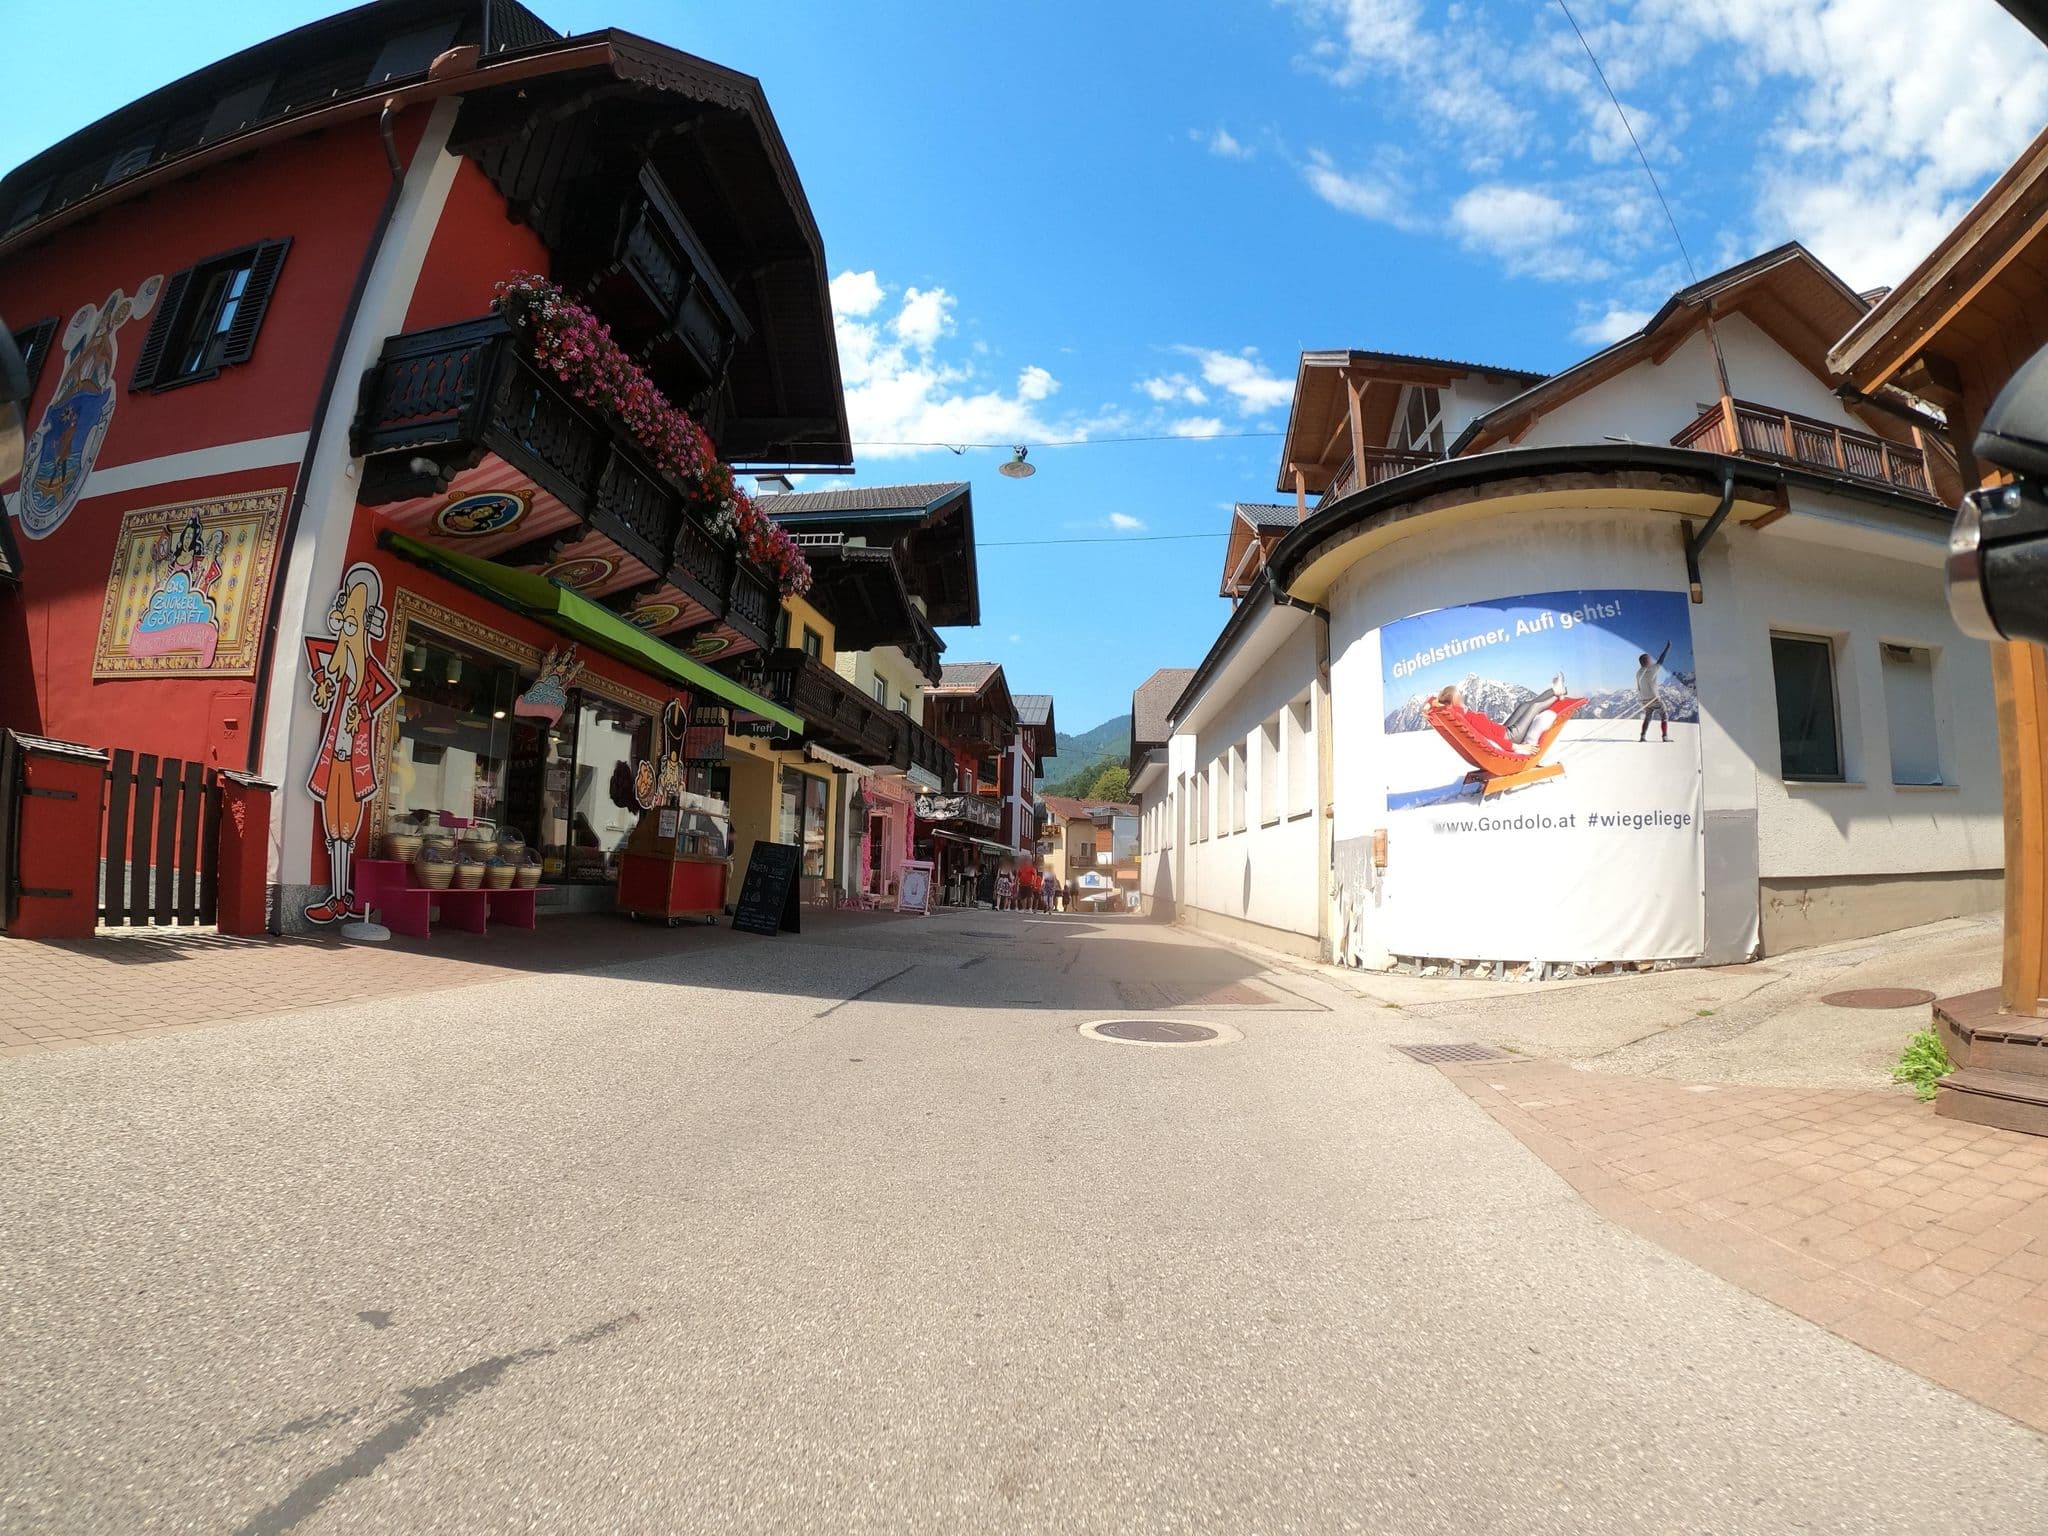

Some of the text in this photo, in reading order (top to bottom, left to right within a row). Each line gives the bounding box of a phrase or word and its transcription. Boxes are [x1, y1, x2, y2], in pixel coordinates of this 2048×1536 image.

[167, 581, 185, 594] DAS
[153, 596, 198, 610] ZUCKERL
[1392, 600, 1622, 678] Gipfelstürmer, Aufi gehts!
[1588, 810, 1692, 829] #wiegeliege
